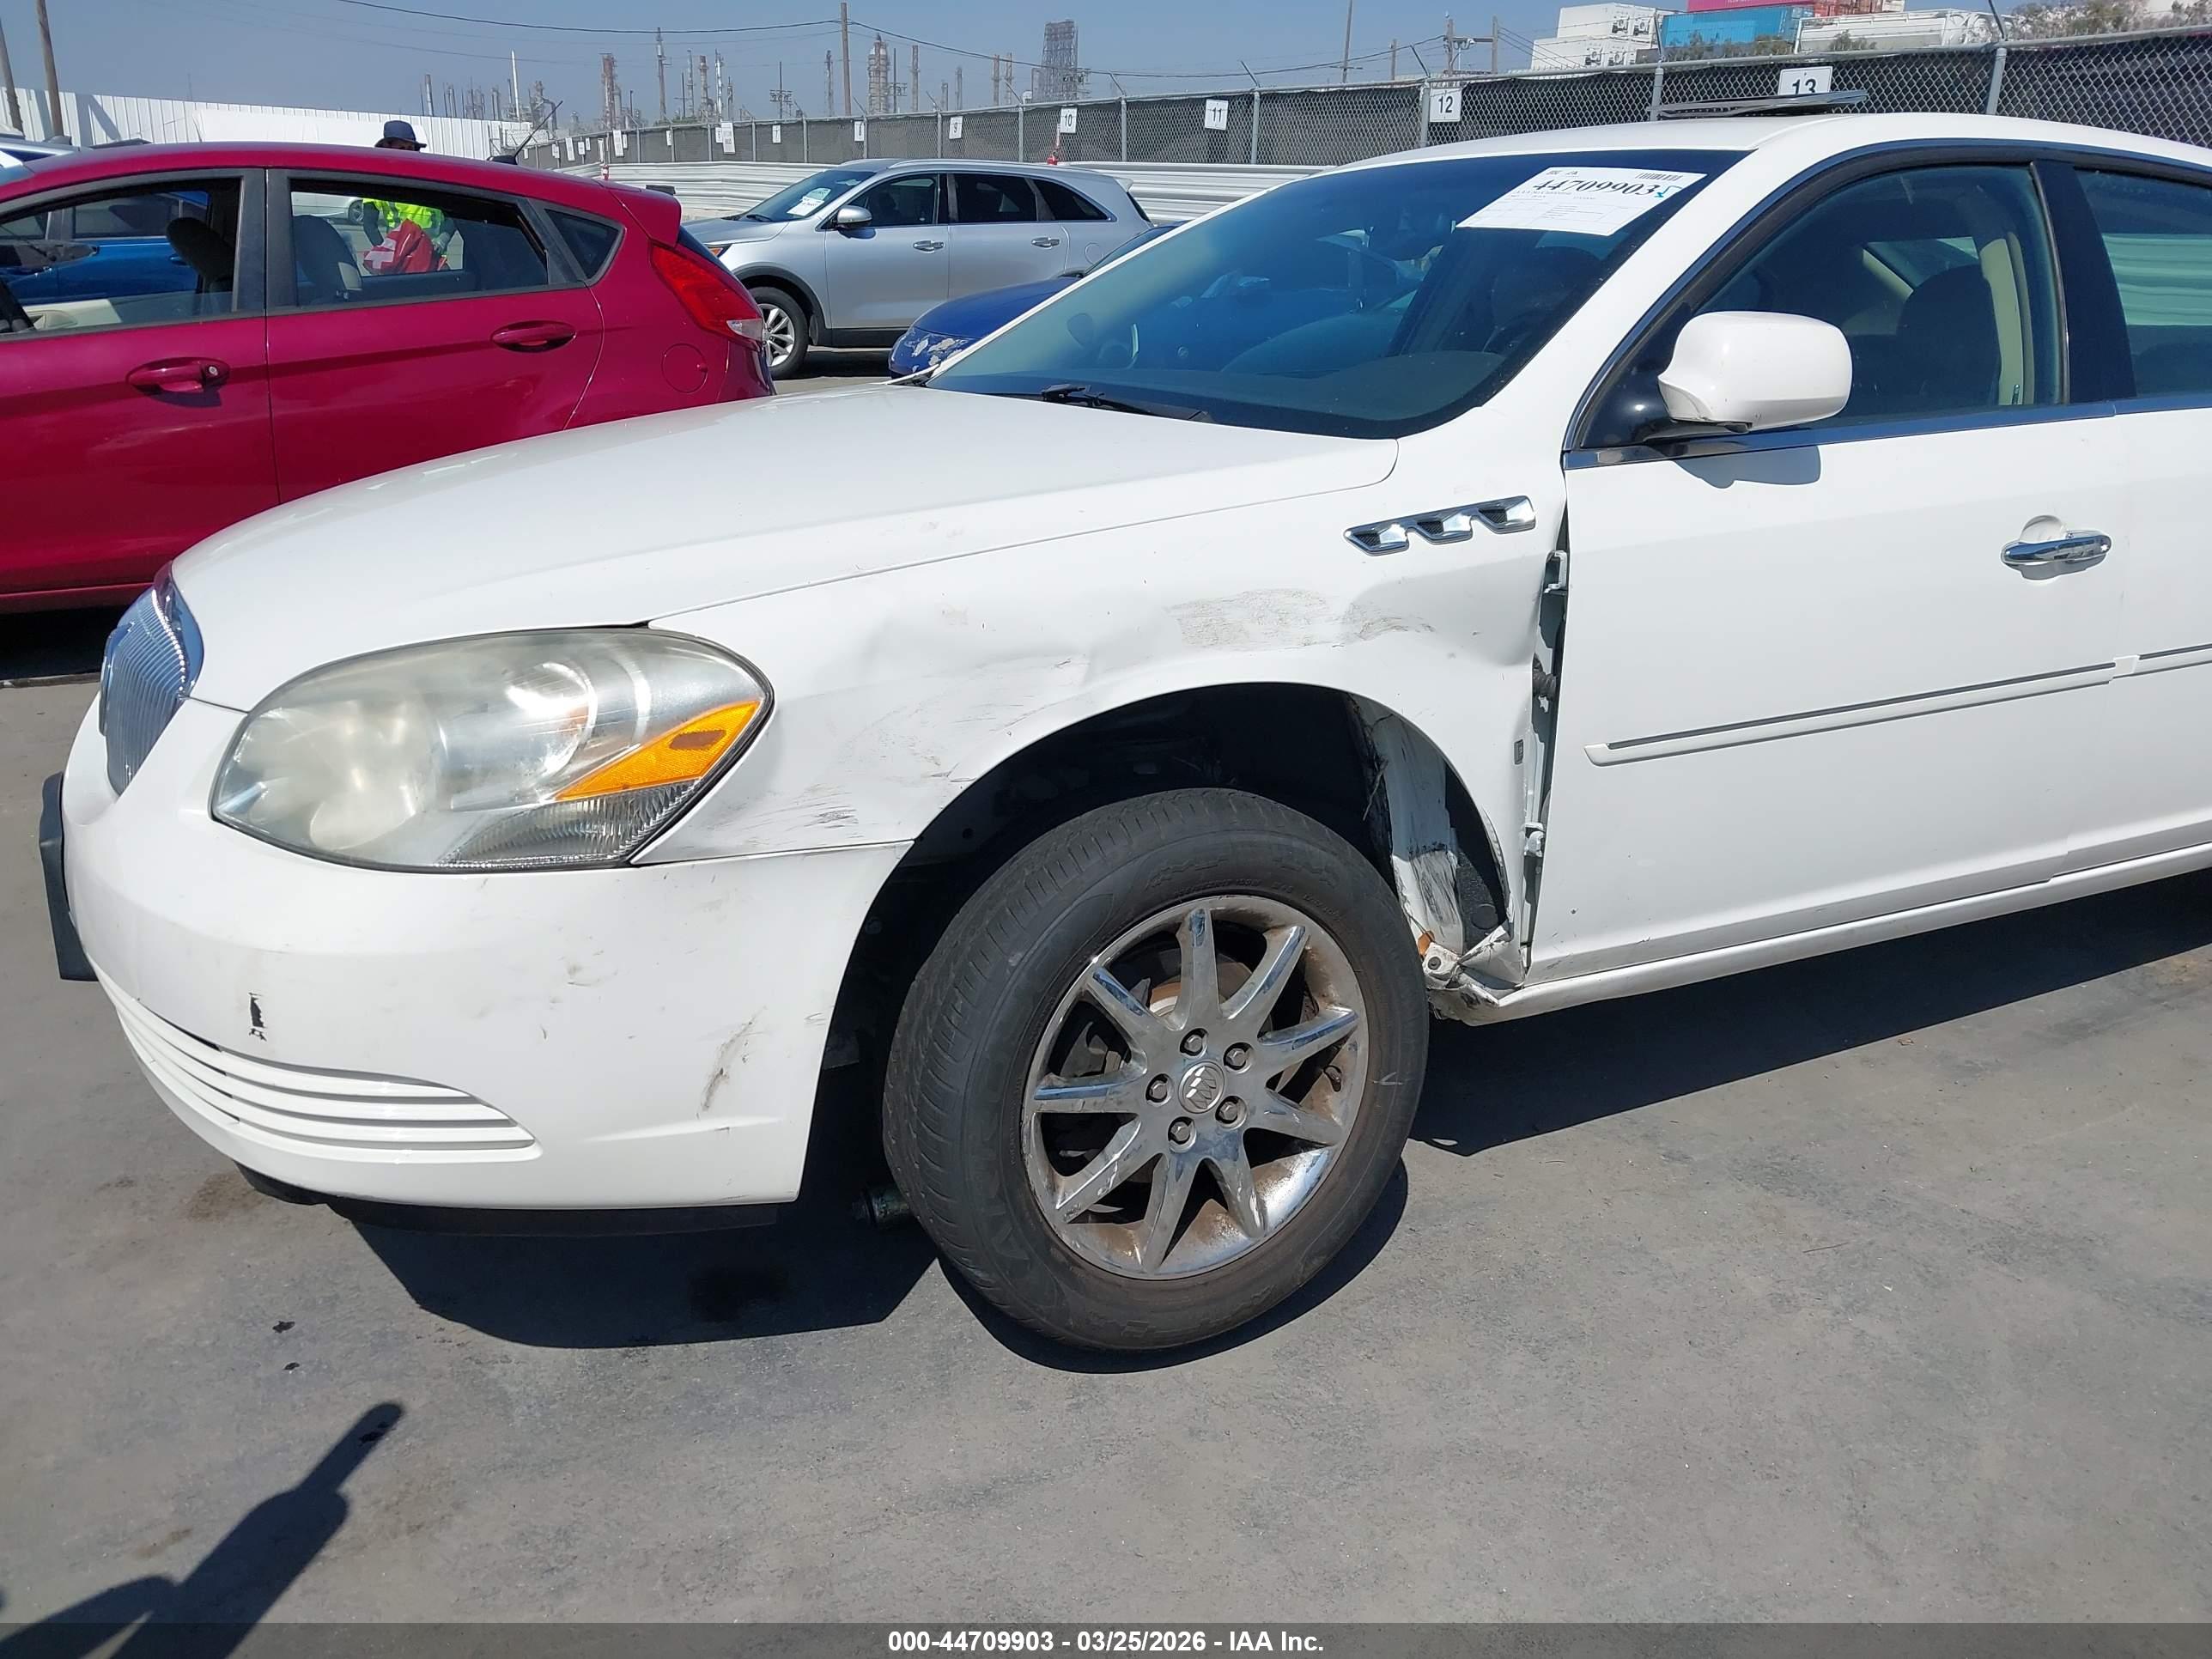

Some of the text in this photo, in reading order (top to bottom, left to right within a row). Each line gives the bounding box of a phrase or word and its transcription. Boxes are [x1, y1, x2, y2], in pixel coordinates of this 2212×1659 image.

[1792, 78, 1816, 94] 13
[1438, 95, 1454, 113] 12
[1065, 113, 1073, 127] 10
[1212, 106, 1223, 123] 11
[953, 122, 958, 133] 9
[1533, 179, 1661, 196] 44709903
